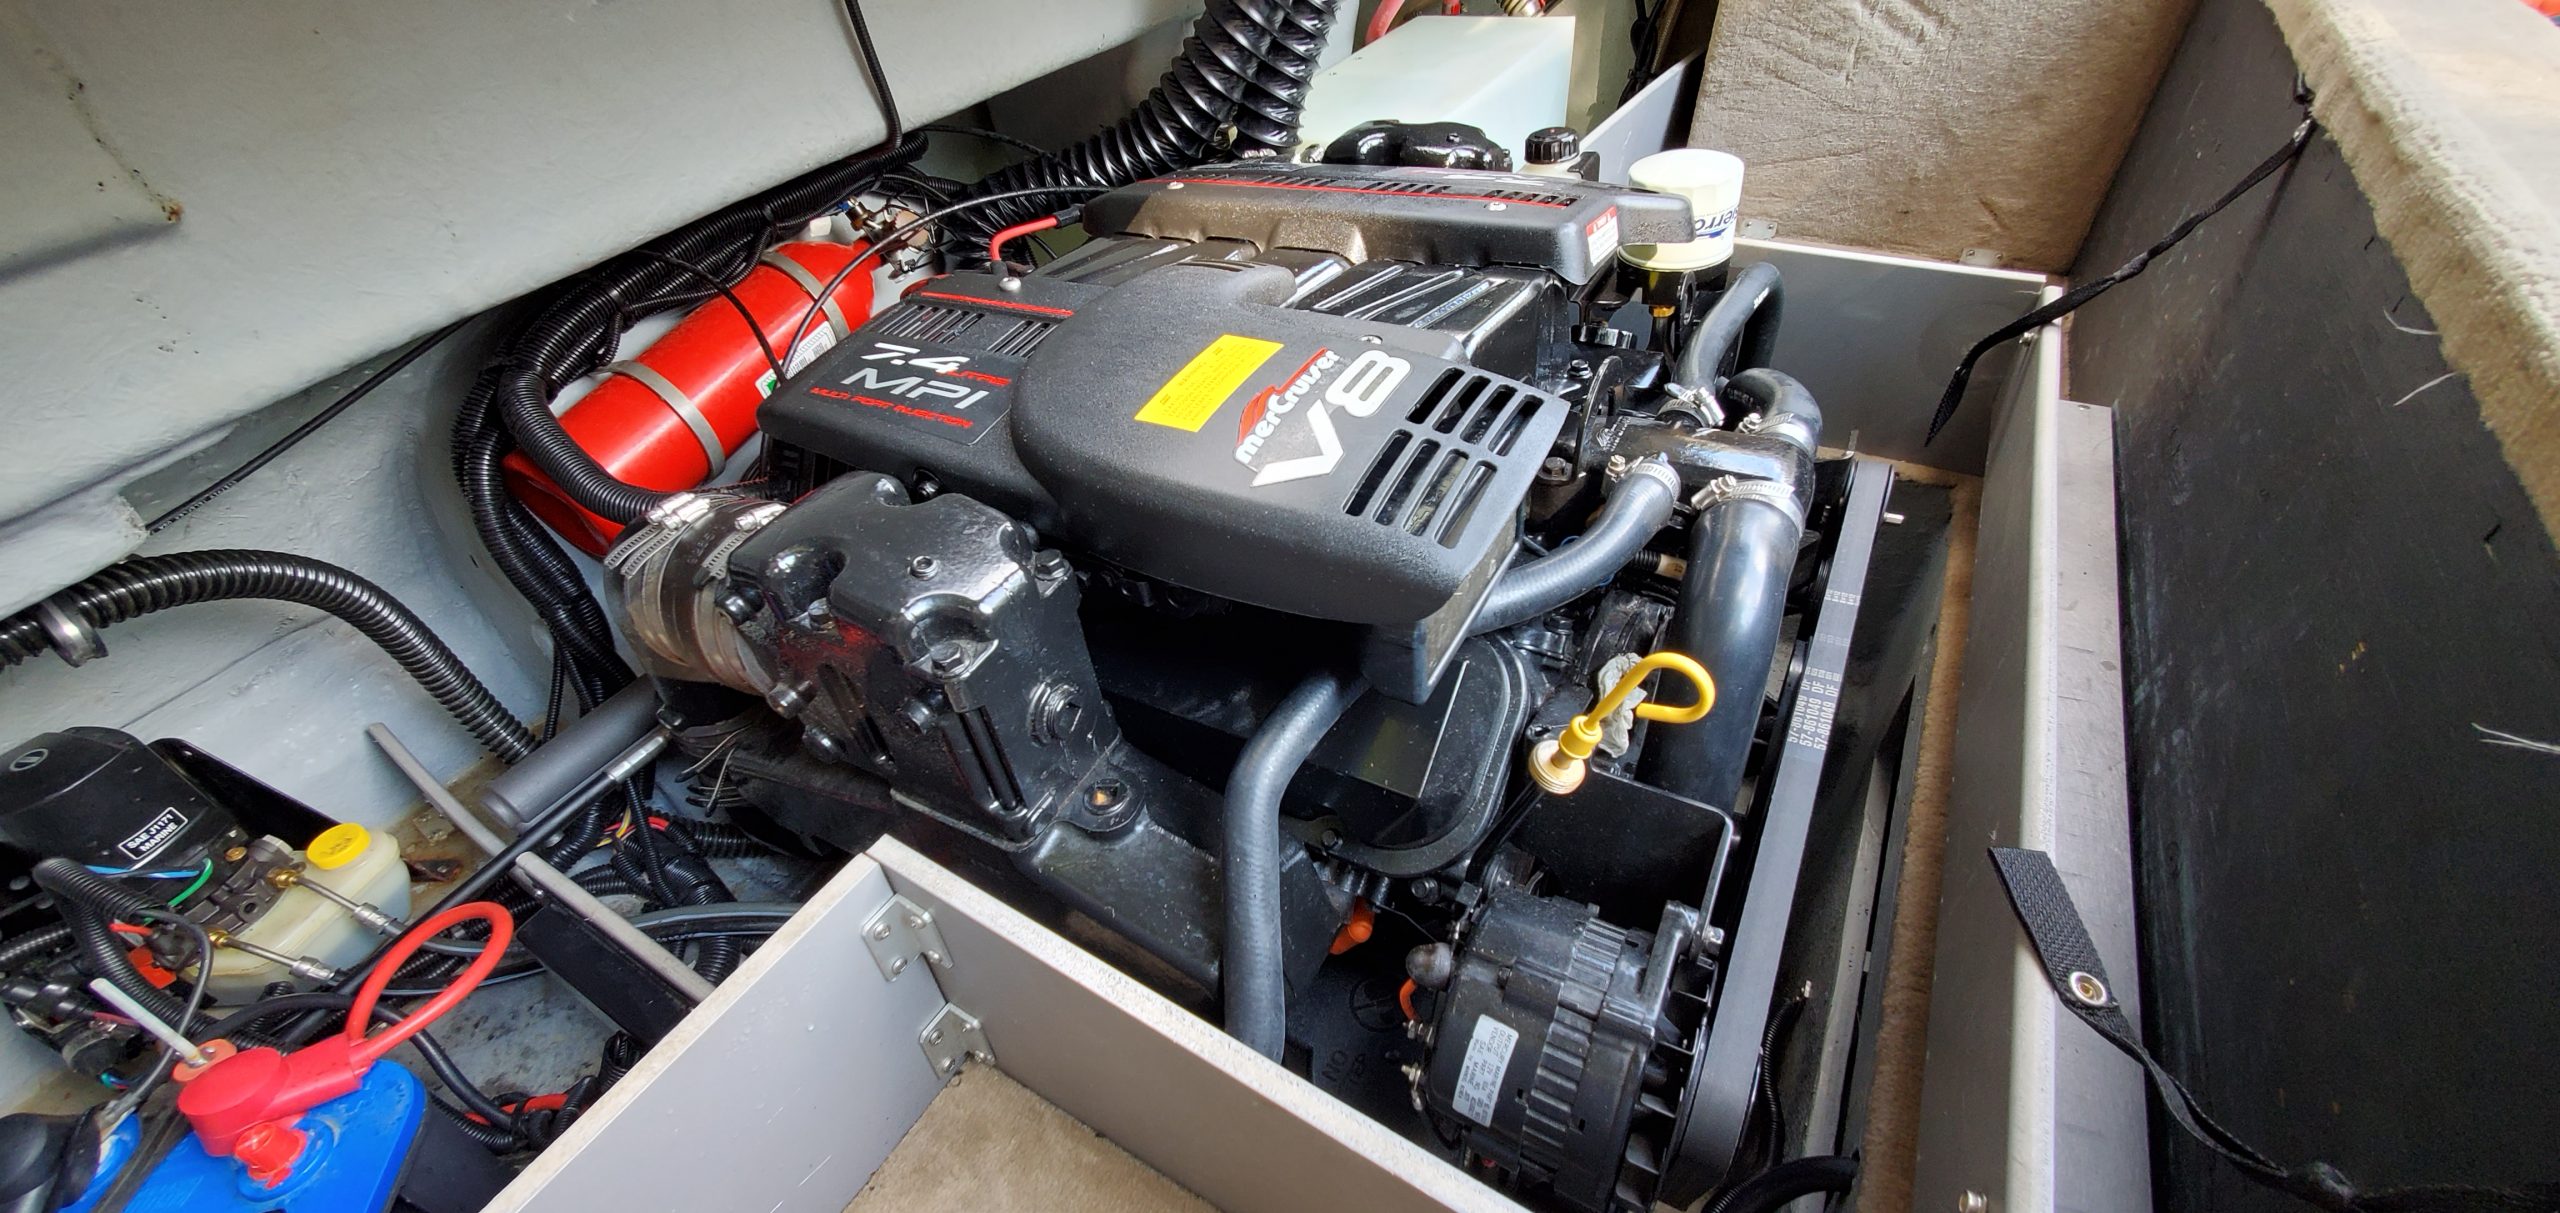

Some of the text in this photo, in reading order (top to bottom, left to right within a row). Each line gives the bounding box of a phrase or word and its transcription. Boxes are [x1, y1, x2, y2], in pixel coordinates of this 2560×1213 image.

[860, 342, 970, 374] 7.4
[810, 387, 974, 428] MULTI PORT INJECTION
[840, 367, 990, 410] MPI
[1250, 350, 1411, 487] V8
[1799, 697, 1822, 747] 57-861049
[1811, 681, 1825, 694] DF
[1813, 701, 1836, 751] 57-861049
[1825, 684, 1839, 697] DF
[127, 813, 174, 849] SAE J1171
[139, 822, 178, 852] MARINE
[1321, 1050, 1347, 1082] NO
